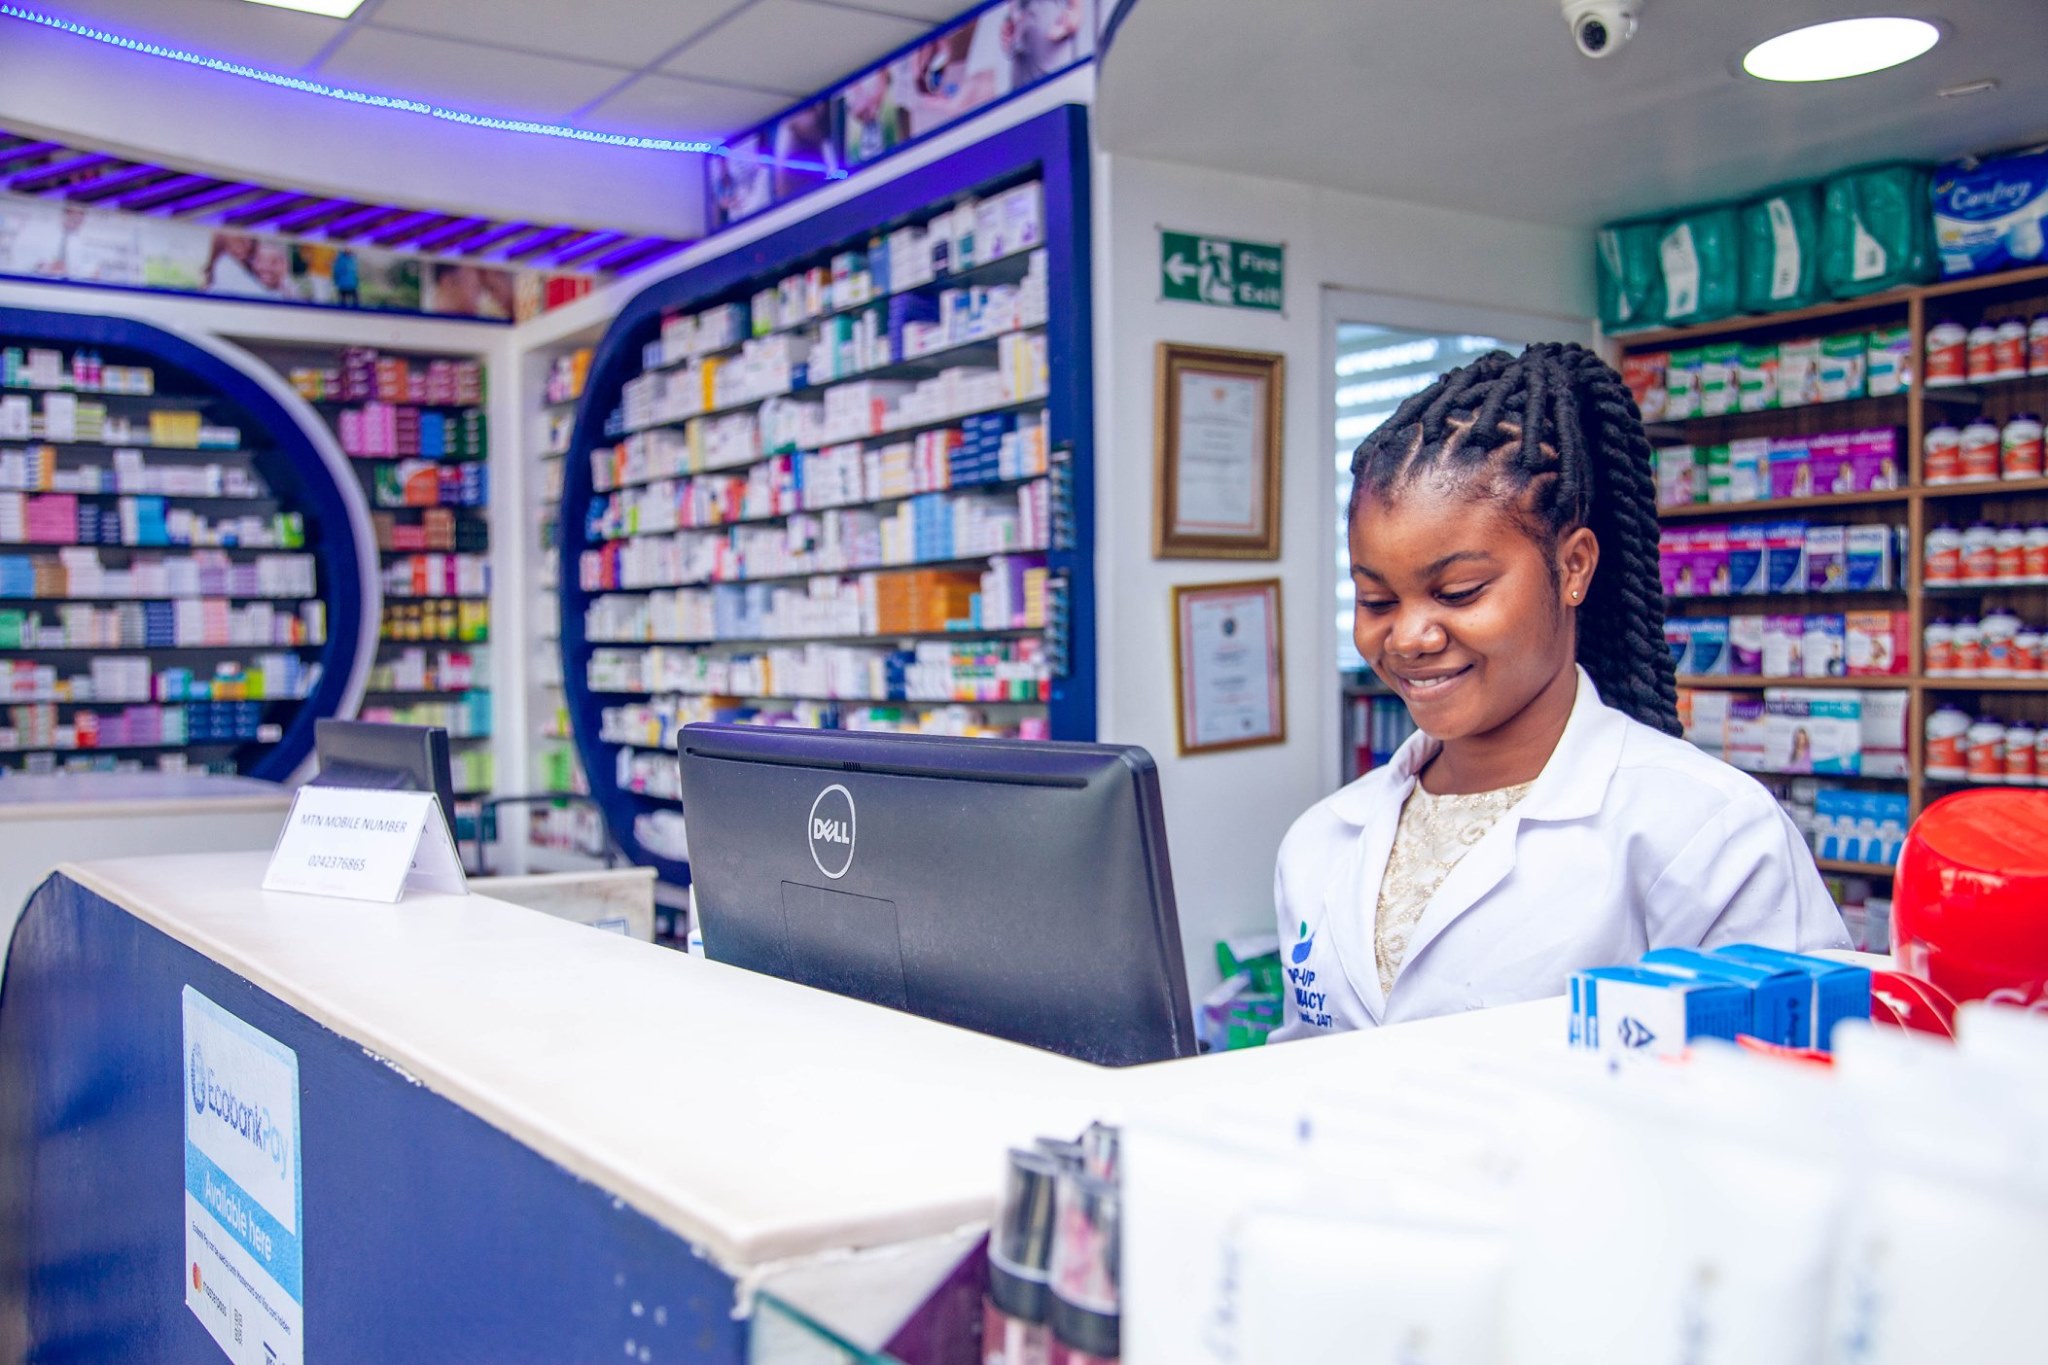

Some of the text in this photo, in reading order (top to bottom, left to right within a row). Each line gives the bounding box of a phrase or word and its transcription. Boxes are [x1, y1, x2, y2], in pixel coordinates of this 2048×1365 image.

[1240, 250, 1279, 273] Fire
[1240, 281, 1280, 304] Exit
[300, 814, 408, 833] MTN MOBILE NUMBER
[813, 818, 850, 845] DELL
[308, 855, 366, 872] 0242376865
[204, 1169, 273, 1262] Available here
